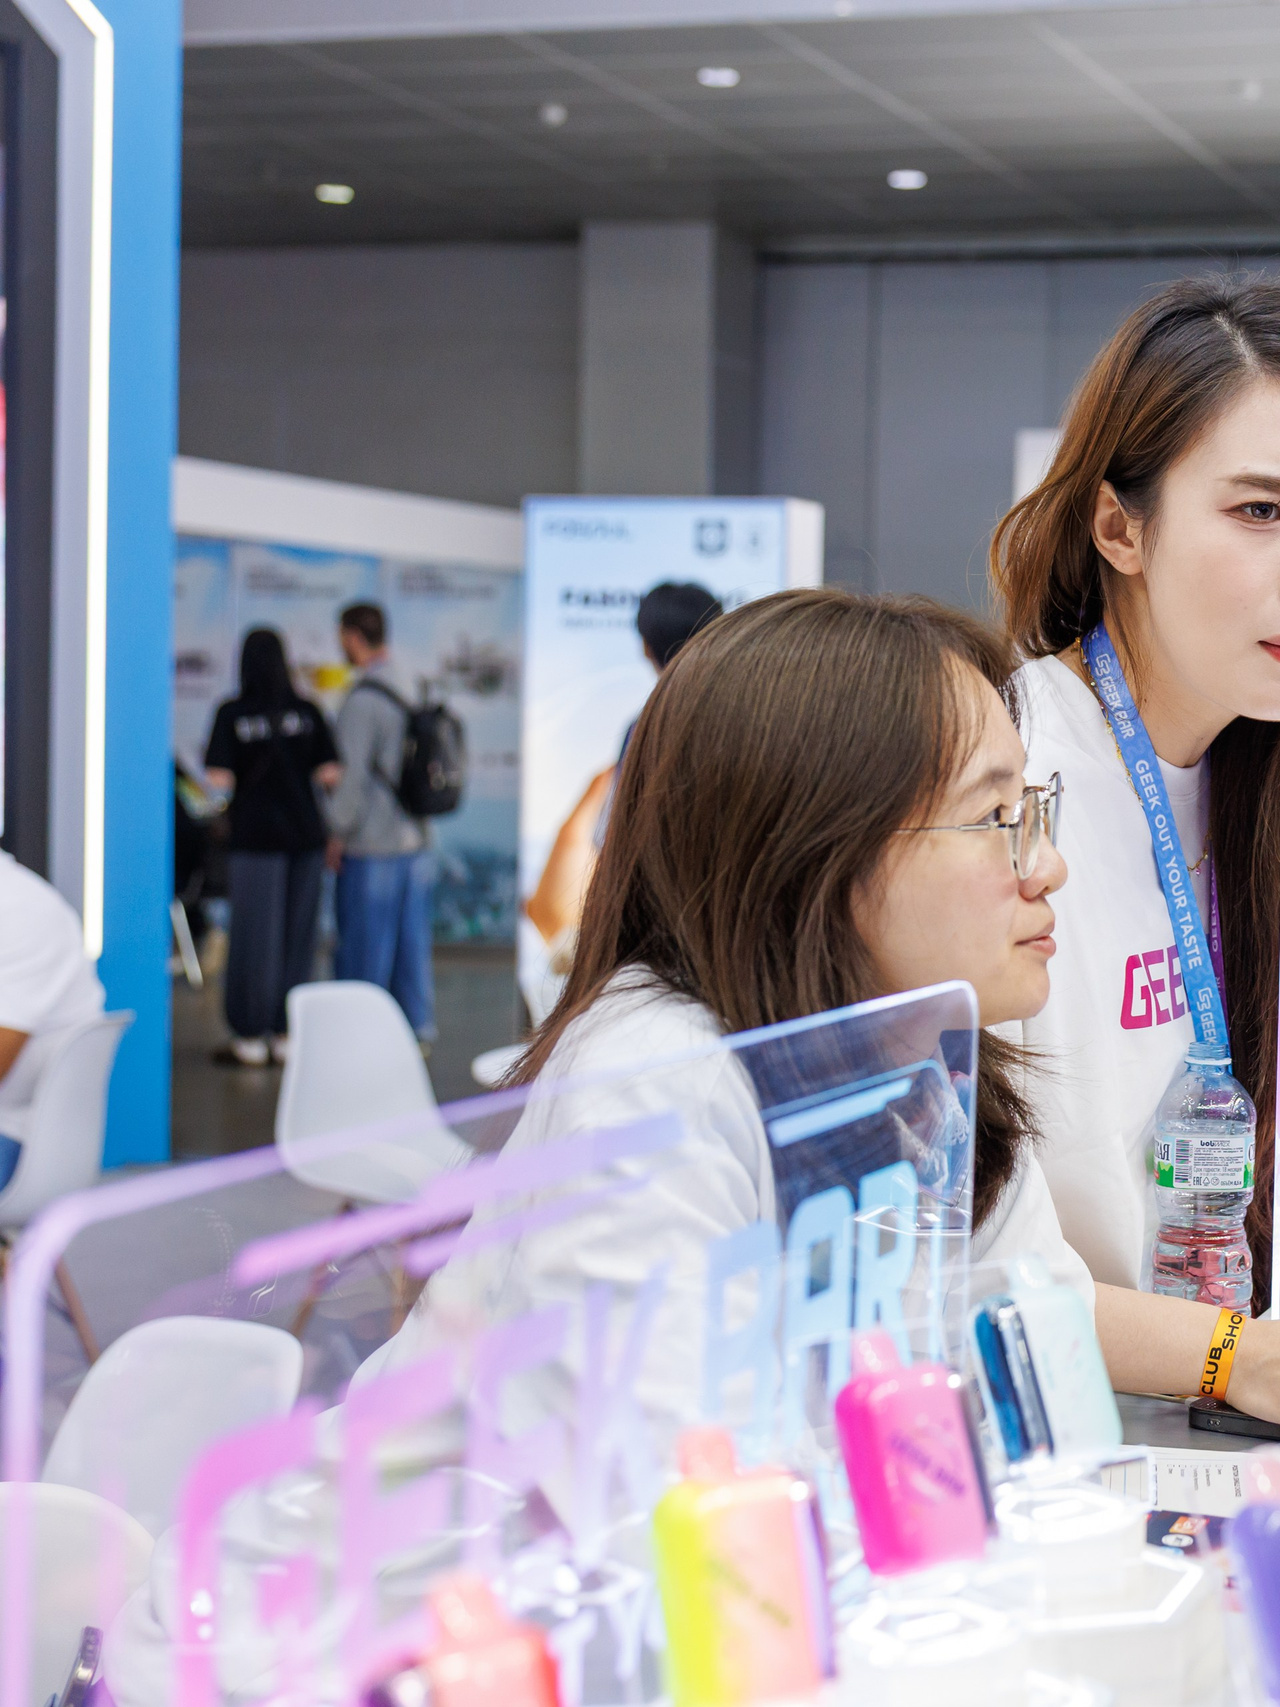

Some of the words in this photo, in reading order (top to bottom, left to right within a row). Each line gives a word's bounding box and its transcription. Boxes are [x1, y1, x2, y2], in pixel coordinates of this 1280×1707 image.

[1100, 676, 1123, 711] GEEK
[1115, 710, 1136, 740] BAR
[1135, 759, 1162, 811] GEEK
[1155, 815, 1174, 851] OUT
[1164, 855, 1188, 910] YOUR
[1178, 911, 1202, 970] TASTE
[1211, 902, 1219, 953] GEEK
[1120, 944, 1191, 1030] GEE
[1200, 1011, 1218, 1045] GEEK
[1201, 1345, 1222, 1396] CLUB
[1222, 1310, 1244, 1351] SHO
